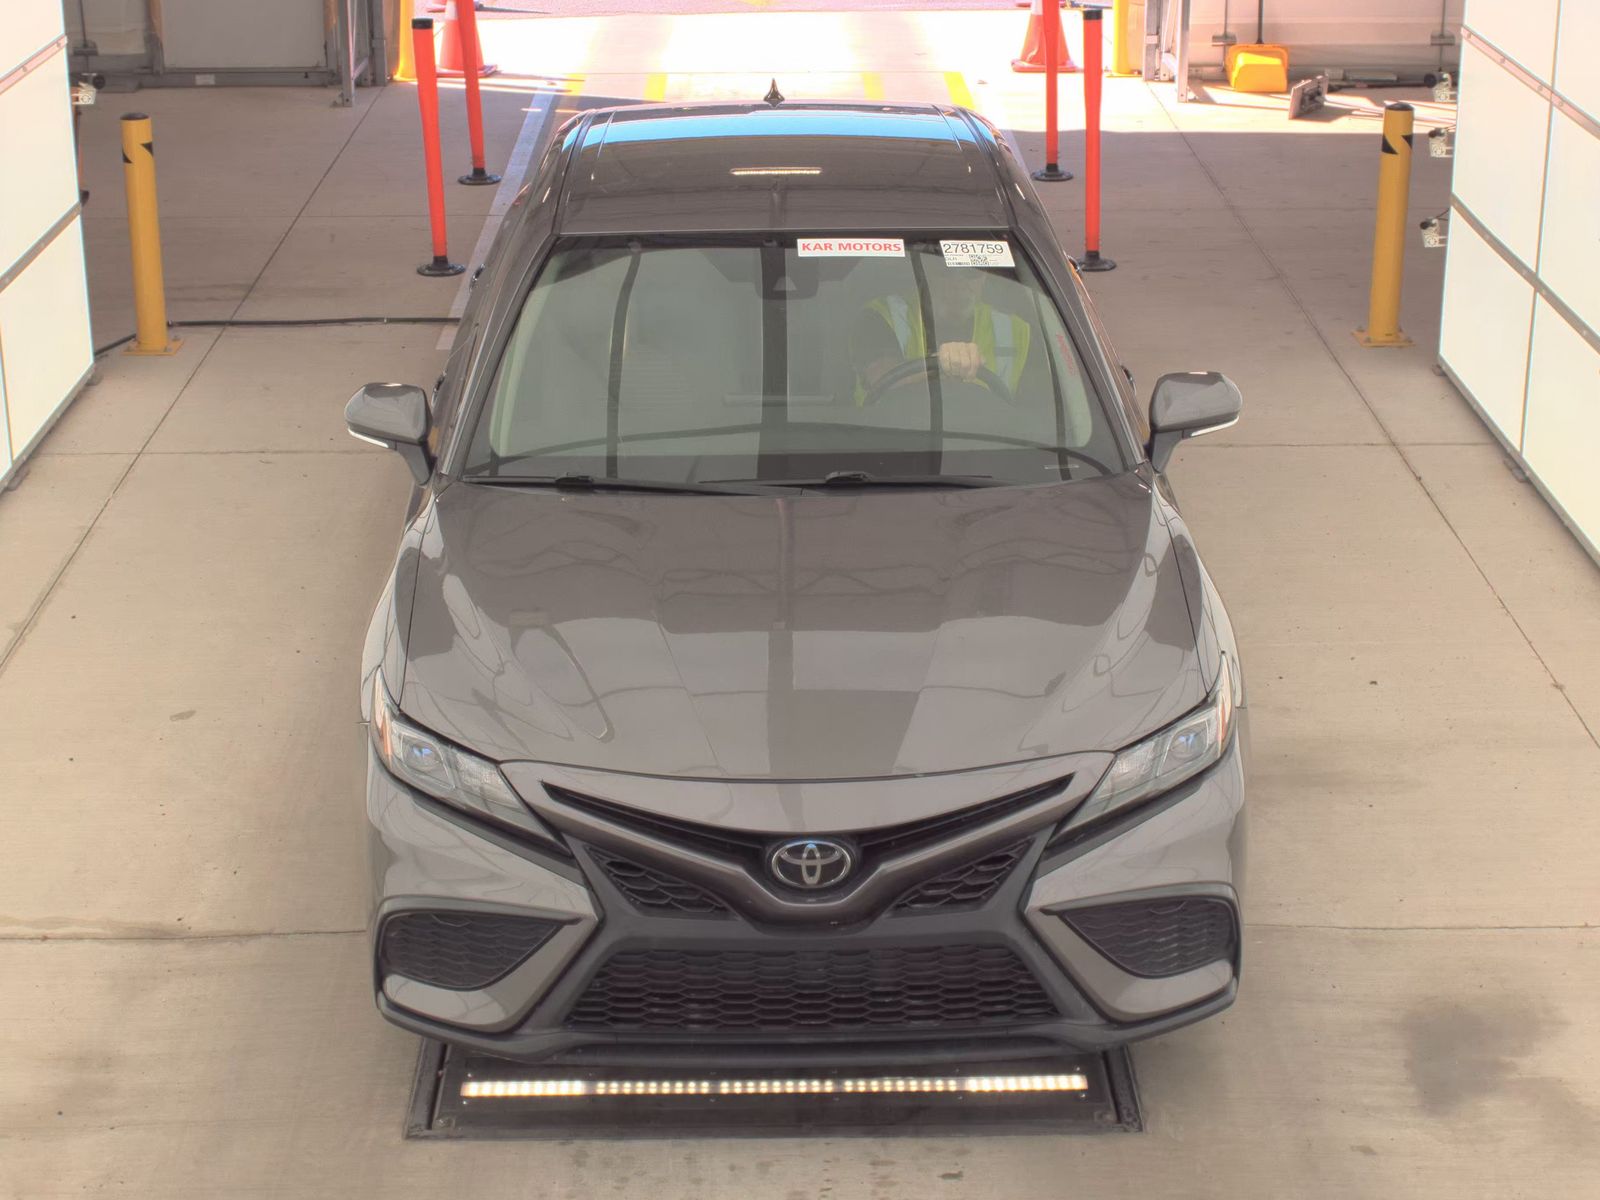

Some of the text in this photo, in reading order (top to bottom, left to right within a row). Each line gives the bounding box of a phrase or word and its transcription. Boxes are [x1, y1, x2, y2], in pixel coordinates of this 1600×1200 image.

[802, 243, 901, 252] KAR MOTORS
[943, 243, 1004, 254] 2781759
